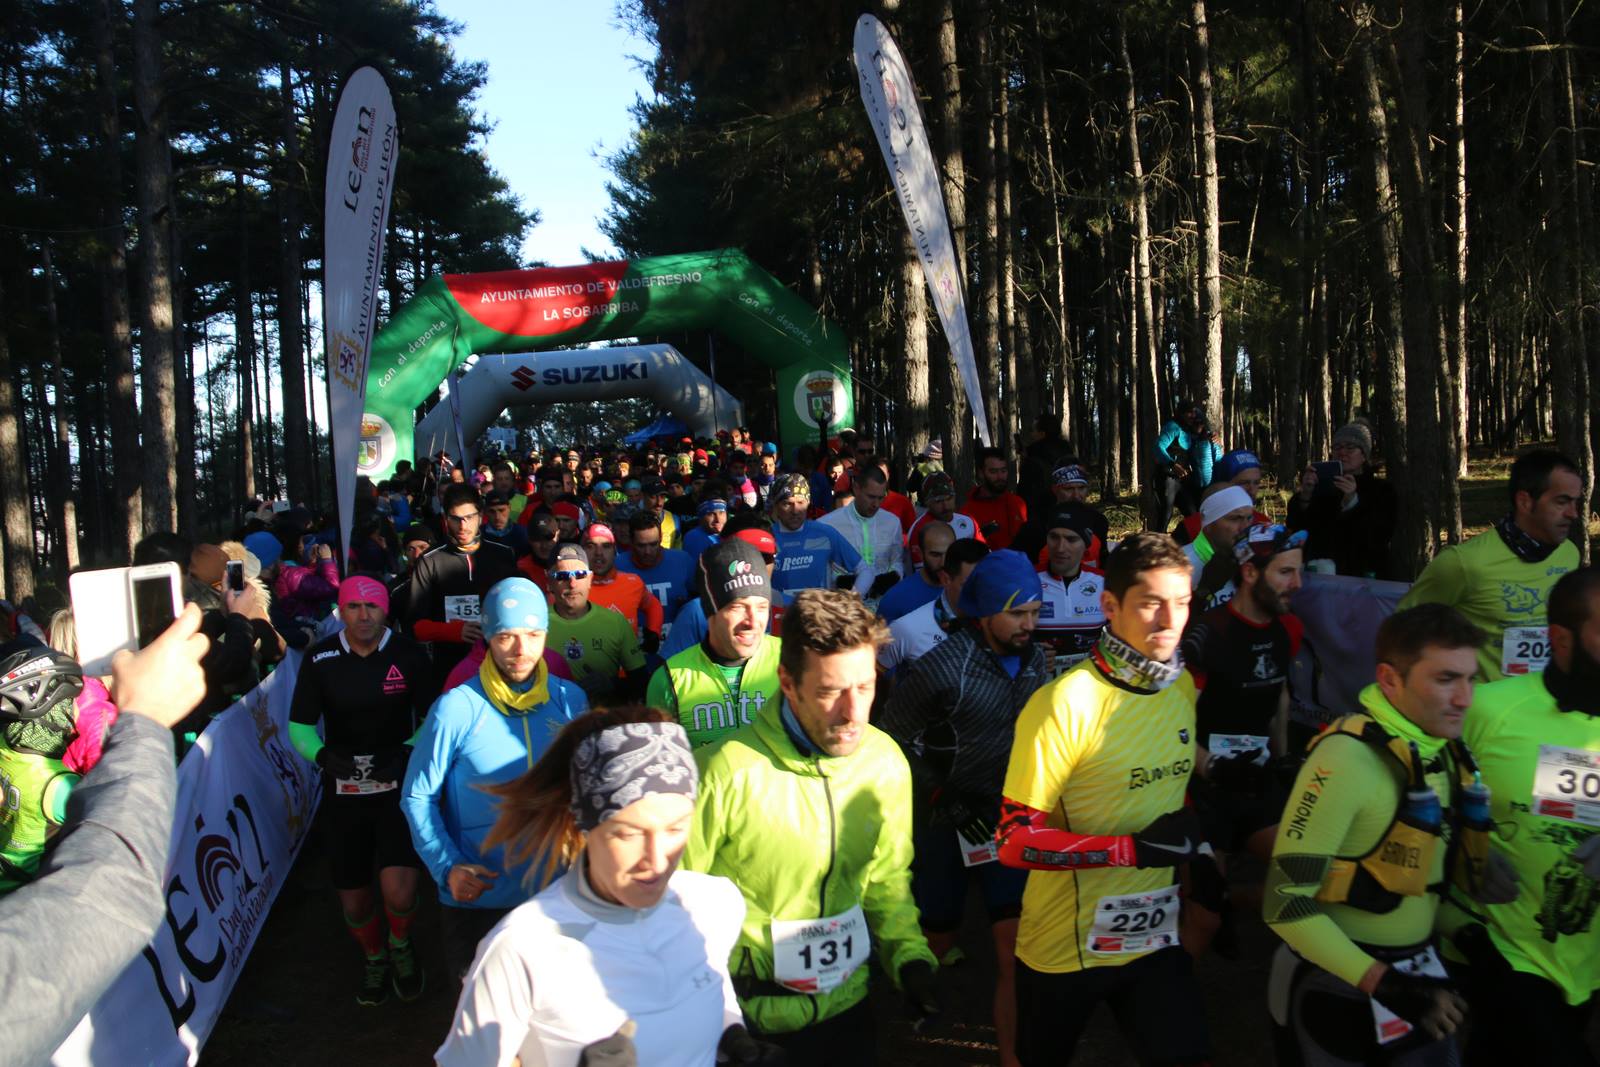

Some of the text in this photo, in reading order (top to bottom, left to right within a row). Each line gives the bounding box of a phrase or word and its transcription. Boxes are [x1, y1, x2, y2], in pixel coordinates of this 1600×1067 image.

[376, 176, 384, 200] DE
[480, 271, 702, 304] AYUNTAMIENTO DE VALDEFRESNO
[543, 300, 639, 321] LA SOBARRIBA
[738, 292, 813, 347] Con el deporte
[378, 320, 448, 388] Con el deporte
[542, 362, 648, 386] SUZUKI
[724, 572, 764, 593] mitto
[455, 604, 480, 616] 153
[1286, 791, 1319, 840] BIONIC
[1109, 908, 1166, 933] 220
[798, 934, 853, 970] 131
